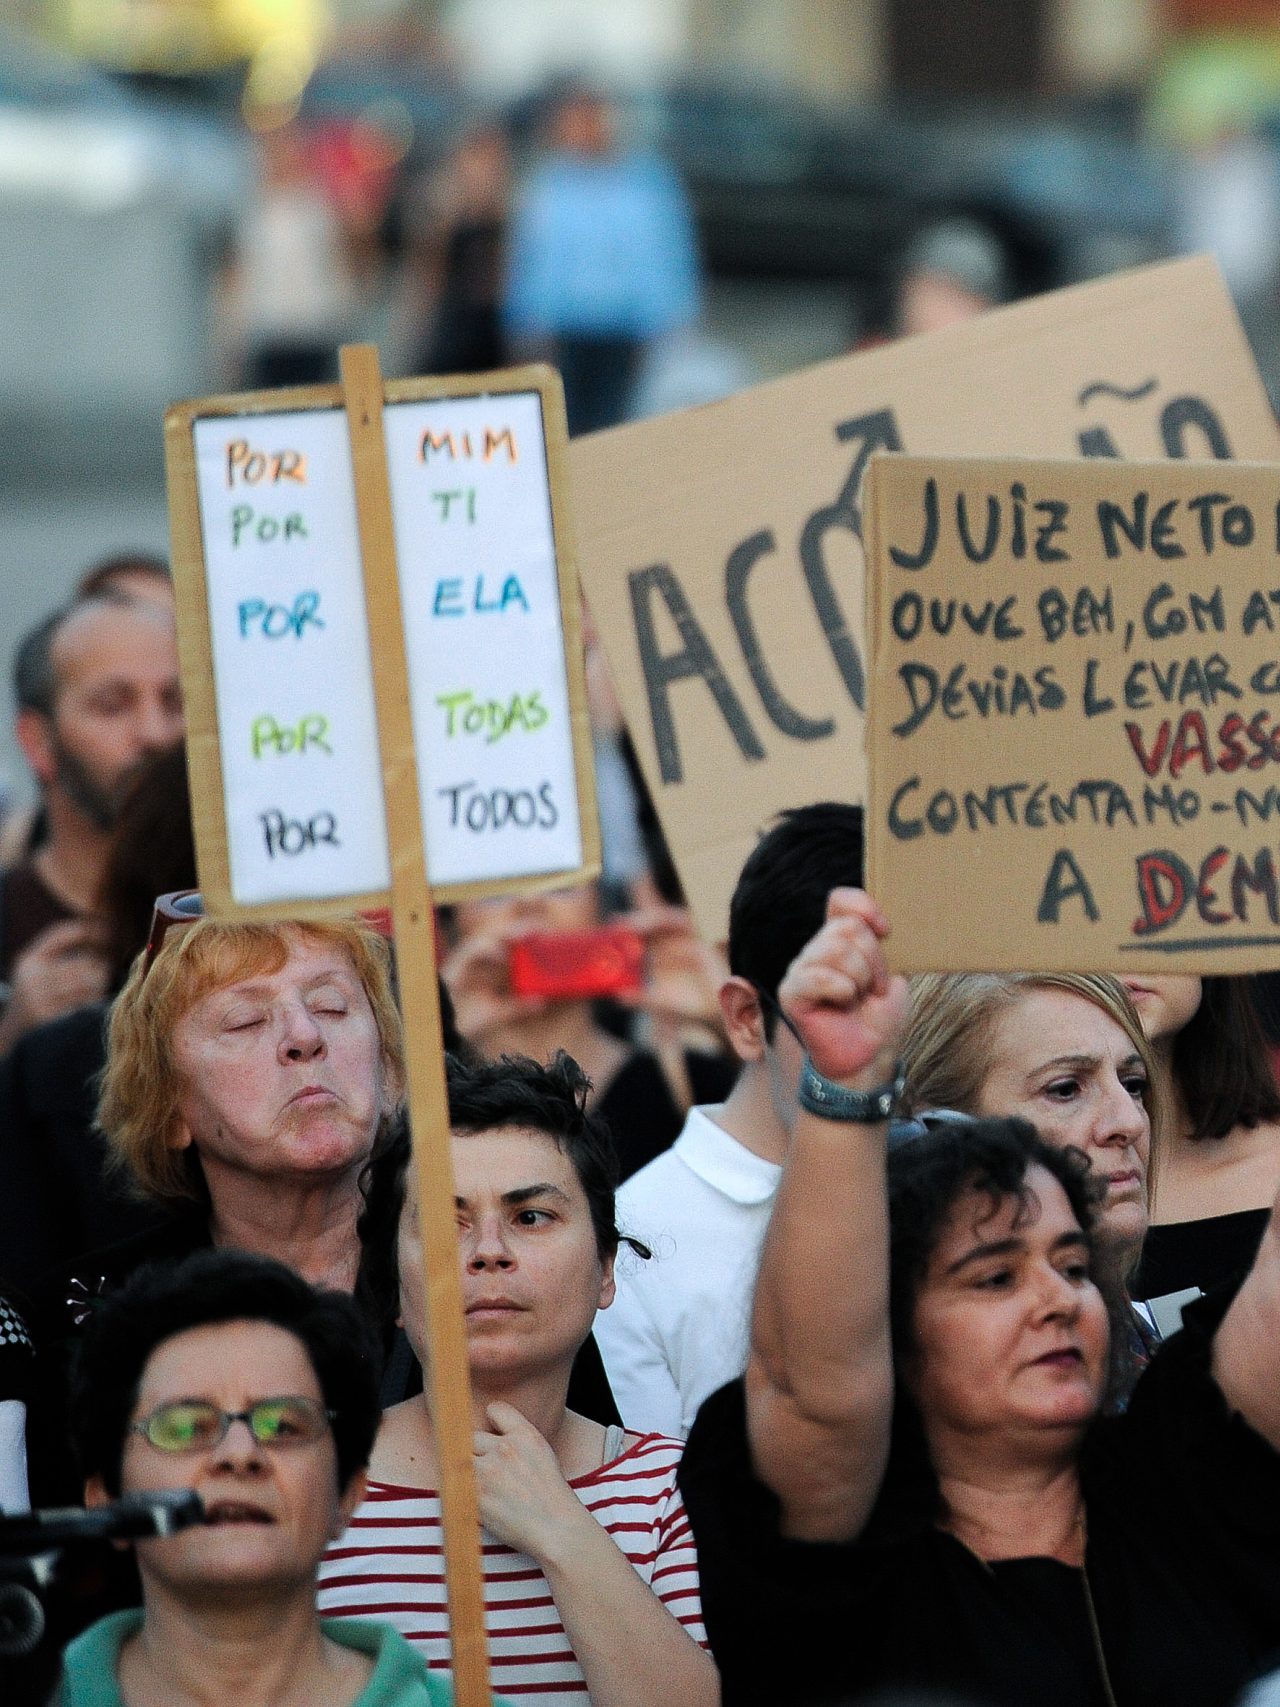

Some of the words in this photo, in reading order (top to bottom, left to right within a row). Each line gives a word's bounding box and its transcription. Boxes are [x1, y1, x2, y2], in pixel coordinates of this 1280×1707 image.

[226, 438, 307, 488] POR
[417, 427, 517, 465] MIM
[232, 506, 308, 547] POR
[434, 489, 475, 523] TI
[888, 478, 1069, 569] JUIZ
[1098, 492, 1254, 558] NETO
[238, 591, 325, 639] POR
[432, 575, 529, 617] ELA
[892, 590, 1023, 642] OUVE
[1143, 582, 1226, 639] COM
[250, 714, 332, 759] POR
[436, 691, 549, 744] TODAS
[893, 661, 1068, 738] DEVIAS
[1084, 654, 1243, 717] LEVAR
[261, 808, 341, 860] POR
[439, 782, 559, 829] TODOS
[1038, 849, 1098, 923] A
